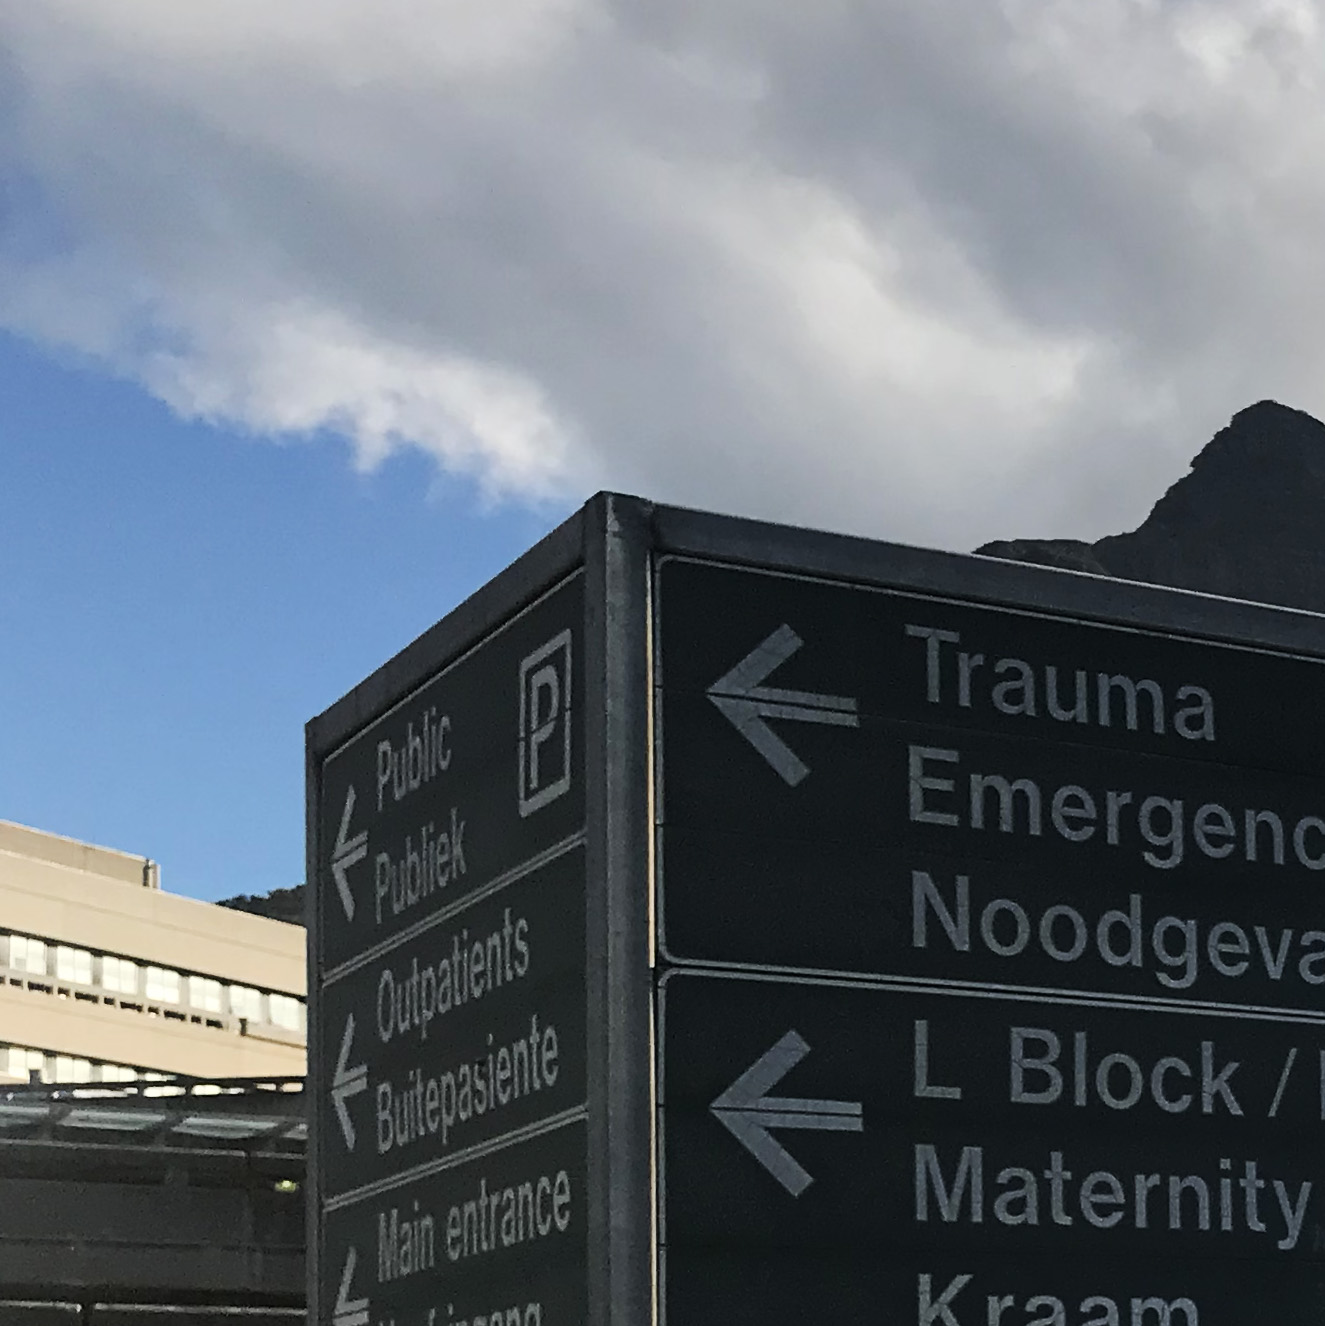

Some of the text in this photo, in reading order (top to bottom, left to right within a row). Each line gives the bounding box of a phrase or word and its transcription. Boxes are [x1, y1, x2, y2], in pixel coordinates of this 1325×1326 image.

[530, 664, 558, 789] P
[905, 624, 1216, 741] Trauma
[377, 706, 452, 811] Public
[376, 807, 466, 924] Publiek
[378, 907, 528, 1043] Outpatients
[377, 1013, 558, 1154] Buitepasiente
[914, 1020, 962, 1101] L
[1011, 1027, 1244, 1117] Block
[1270, 1047, 1298, 1117] /
[378, 1169, 571, 1282] Main entrance
[914, 1145, 1312, 1250] Maternity
